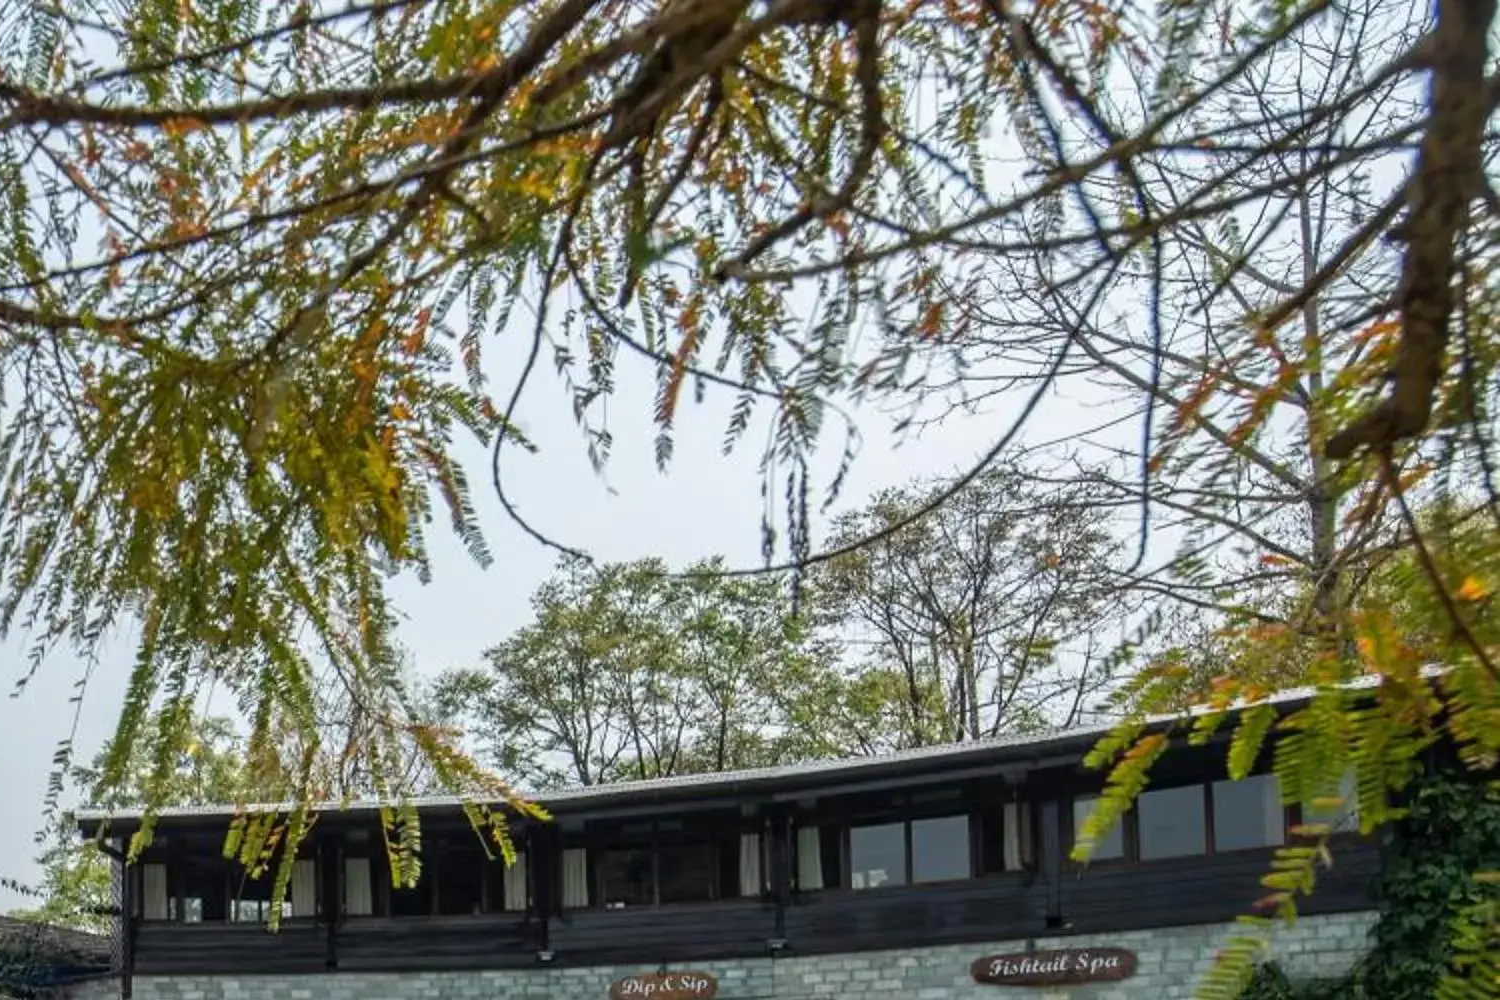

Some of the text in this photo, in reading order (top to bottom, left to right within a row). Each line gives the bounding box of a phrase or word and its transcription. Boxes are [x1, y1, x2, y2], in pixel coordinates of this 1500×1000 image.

[989, 952, 1120, 977] Fishtail Spa
[620, 979, 656, 997] Dip
[679, 975, 708, 993] Sip
